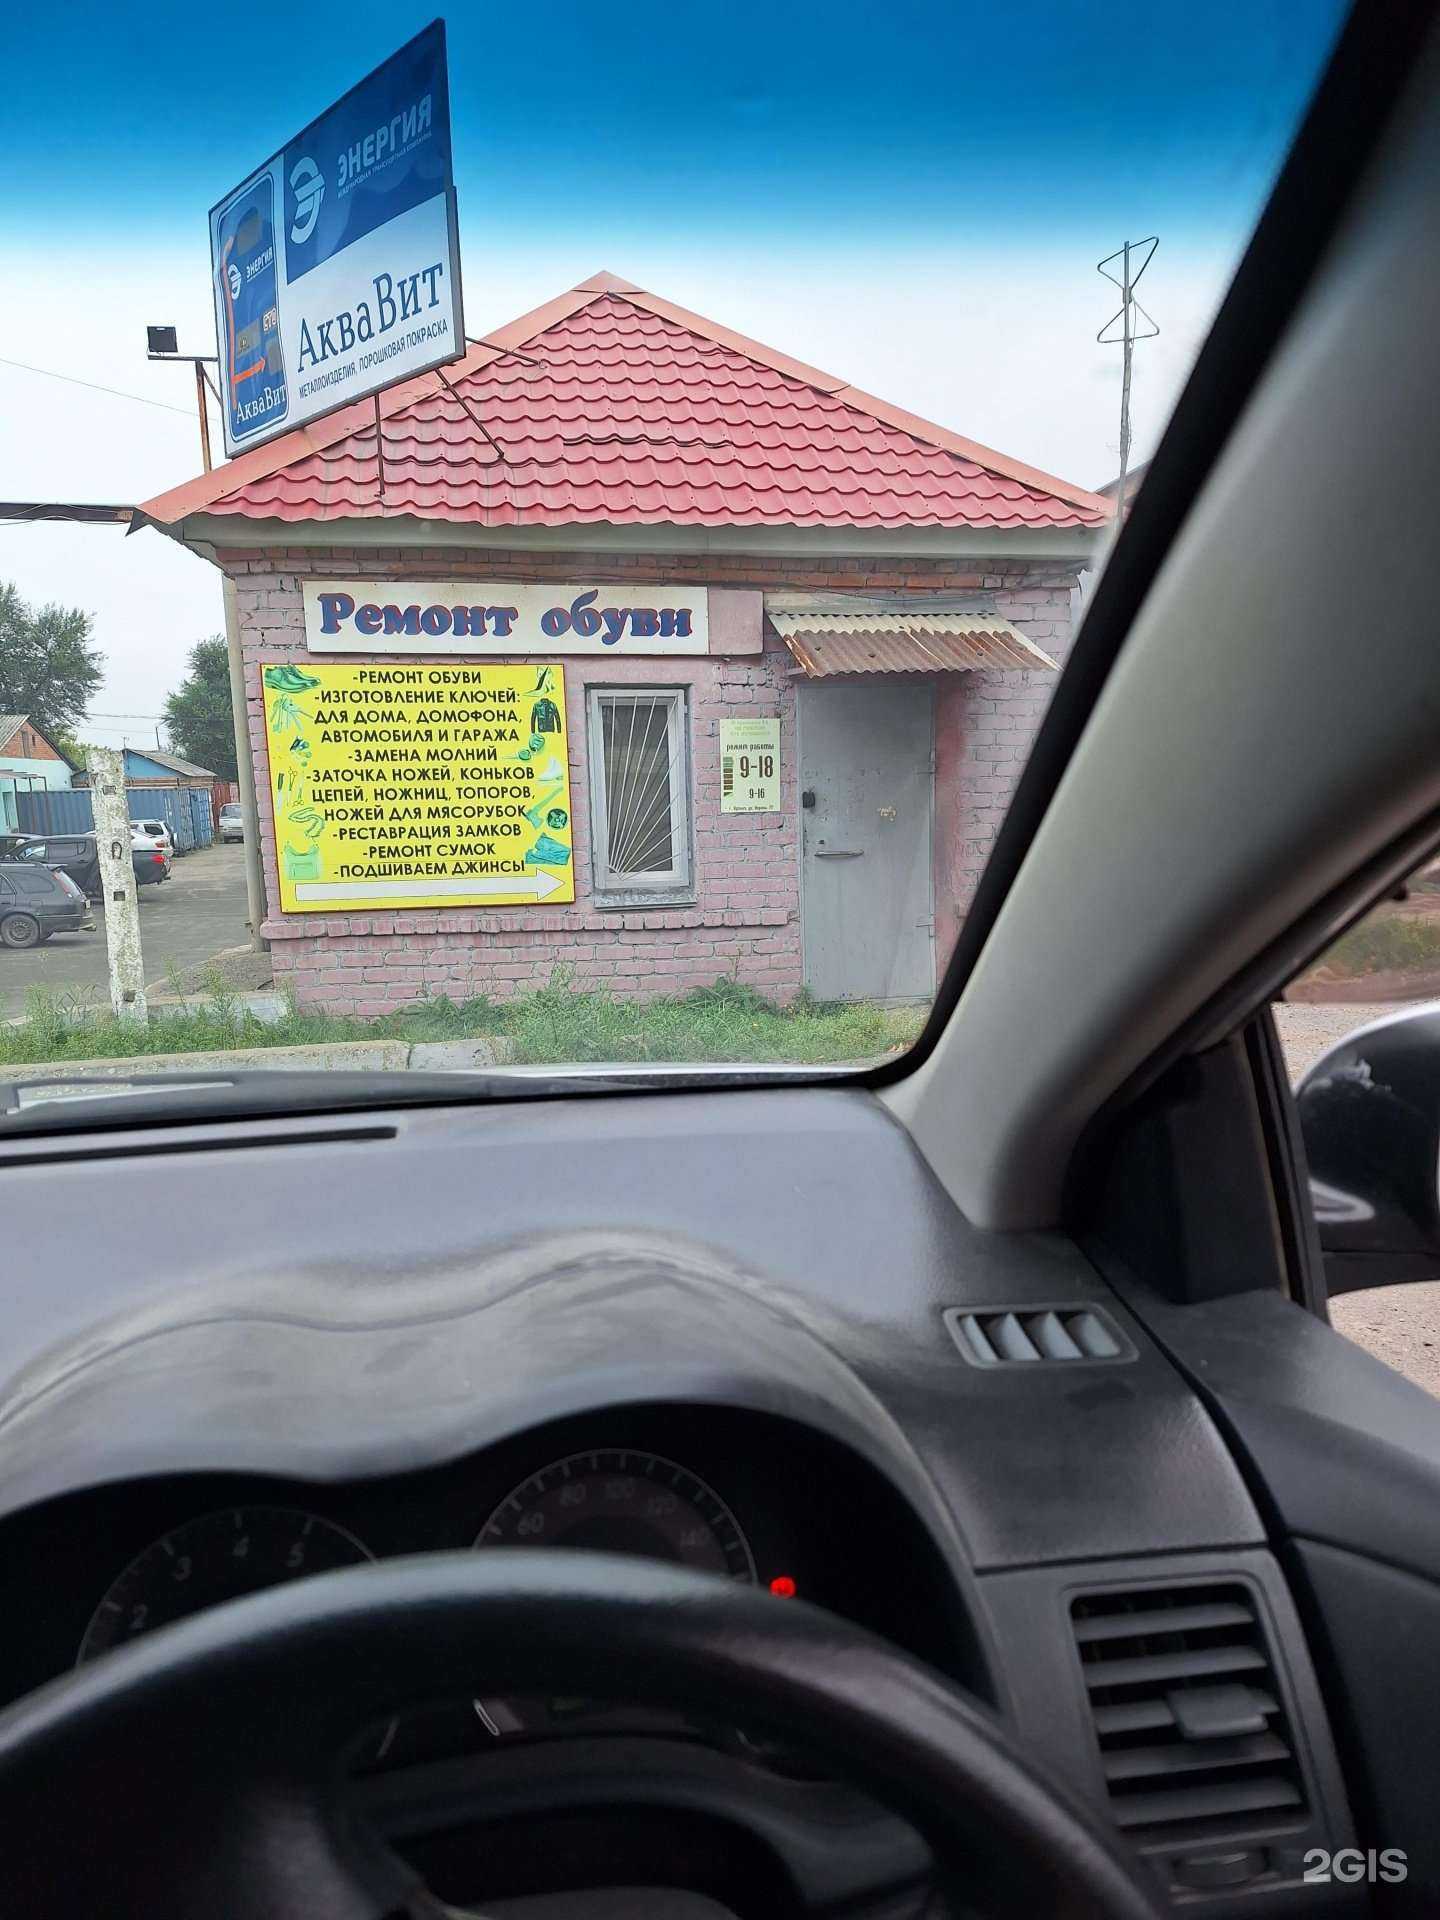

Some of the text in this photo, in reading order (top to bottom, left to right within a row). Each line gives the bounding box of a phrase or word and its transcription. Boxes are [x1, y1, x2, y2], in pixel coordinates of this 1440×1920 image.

[337, 94, 432, 188] ЭНЕРГИЯ
[246, 246, 273, 279] ЭНЕРГИЯ
[298, 318, 449, 399] МЕТАЛЛОИЗДЕЛИЯ, ПОРОШКОВАЯ ПОКРАСКА
[317, 589, 693, 645] Ремонт обуви
[352, 671, 482, 684] -РЕМОНТ ОБУВИ
[314, 688, 520, 704] -ИЗГОТОВЛЕНИЕ КЛЮЧЕЙ:
[314, 710, 522, 725] ДЛЯ ДОМА, ДОМОФОНА,
[321, 729, 519, 743] АВТОМОБИЛЯ И ГАРАЖА
[348, 745, 498, 762] -ЗАМЕНА МОЛНИЙ
[306, 766, 535, 782] -ЗАТОЧКА НОЖЕЙ, КОНЬКОВ
[740, 755, 774, 778] 9-18
[312, 786, 535, 803] ЦЕПЕЙ, НОЖНИЦ, ТОПОРОВ,
[324, 805, 527, 821] НОЖЕЙ ДЛЯ МЯСОРУБОК
[332, 823, 522, 840] -РЕСТАВРАЦИЯ ЗАМКОВ
[362, 843, 496, 859] -РЕМОНТ СУМОК
[334, 860, 525, 878] -ПОДШИВАЕМ ДЖИНСЫ
[517, 1513, 546, 1537] 60
[231, 1537, 251, 1559] 4
[173, 1555, 192, 1581] 3
[130, 1604, 149, 1630] 2
